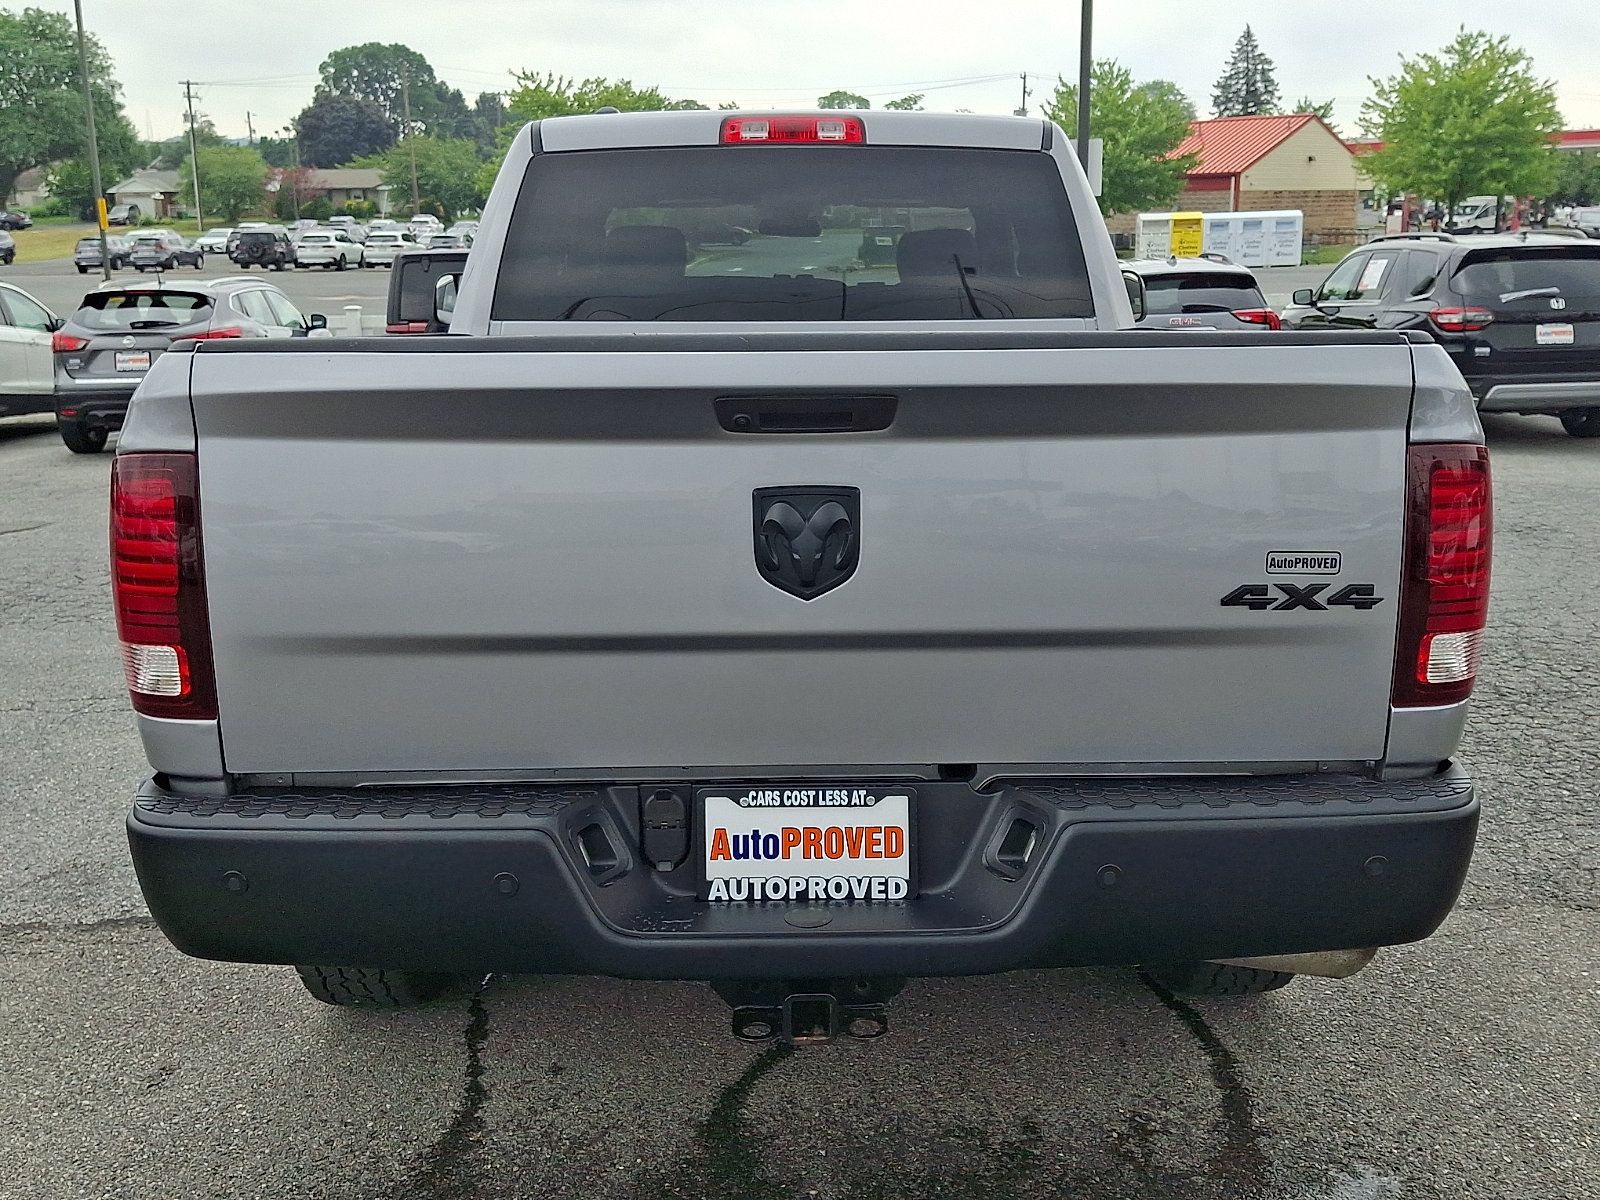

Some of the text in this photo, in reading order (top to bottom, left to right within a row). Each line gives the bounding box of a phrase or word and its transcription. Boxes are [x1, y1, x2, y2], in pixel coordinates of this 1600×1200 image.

[1269, 557, 1338, 569] AutoPROVED
[748, 789, 867, 806] CARS COST LESS AT
[710, 826, 904, 860] AutoPROVED
[707, 876, 908, 900] AUTOPROVED
